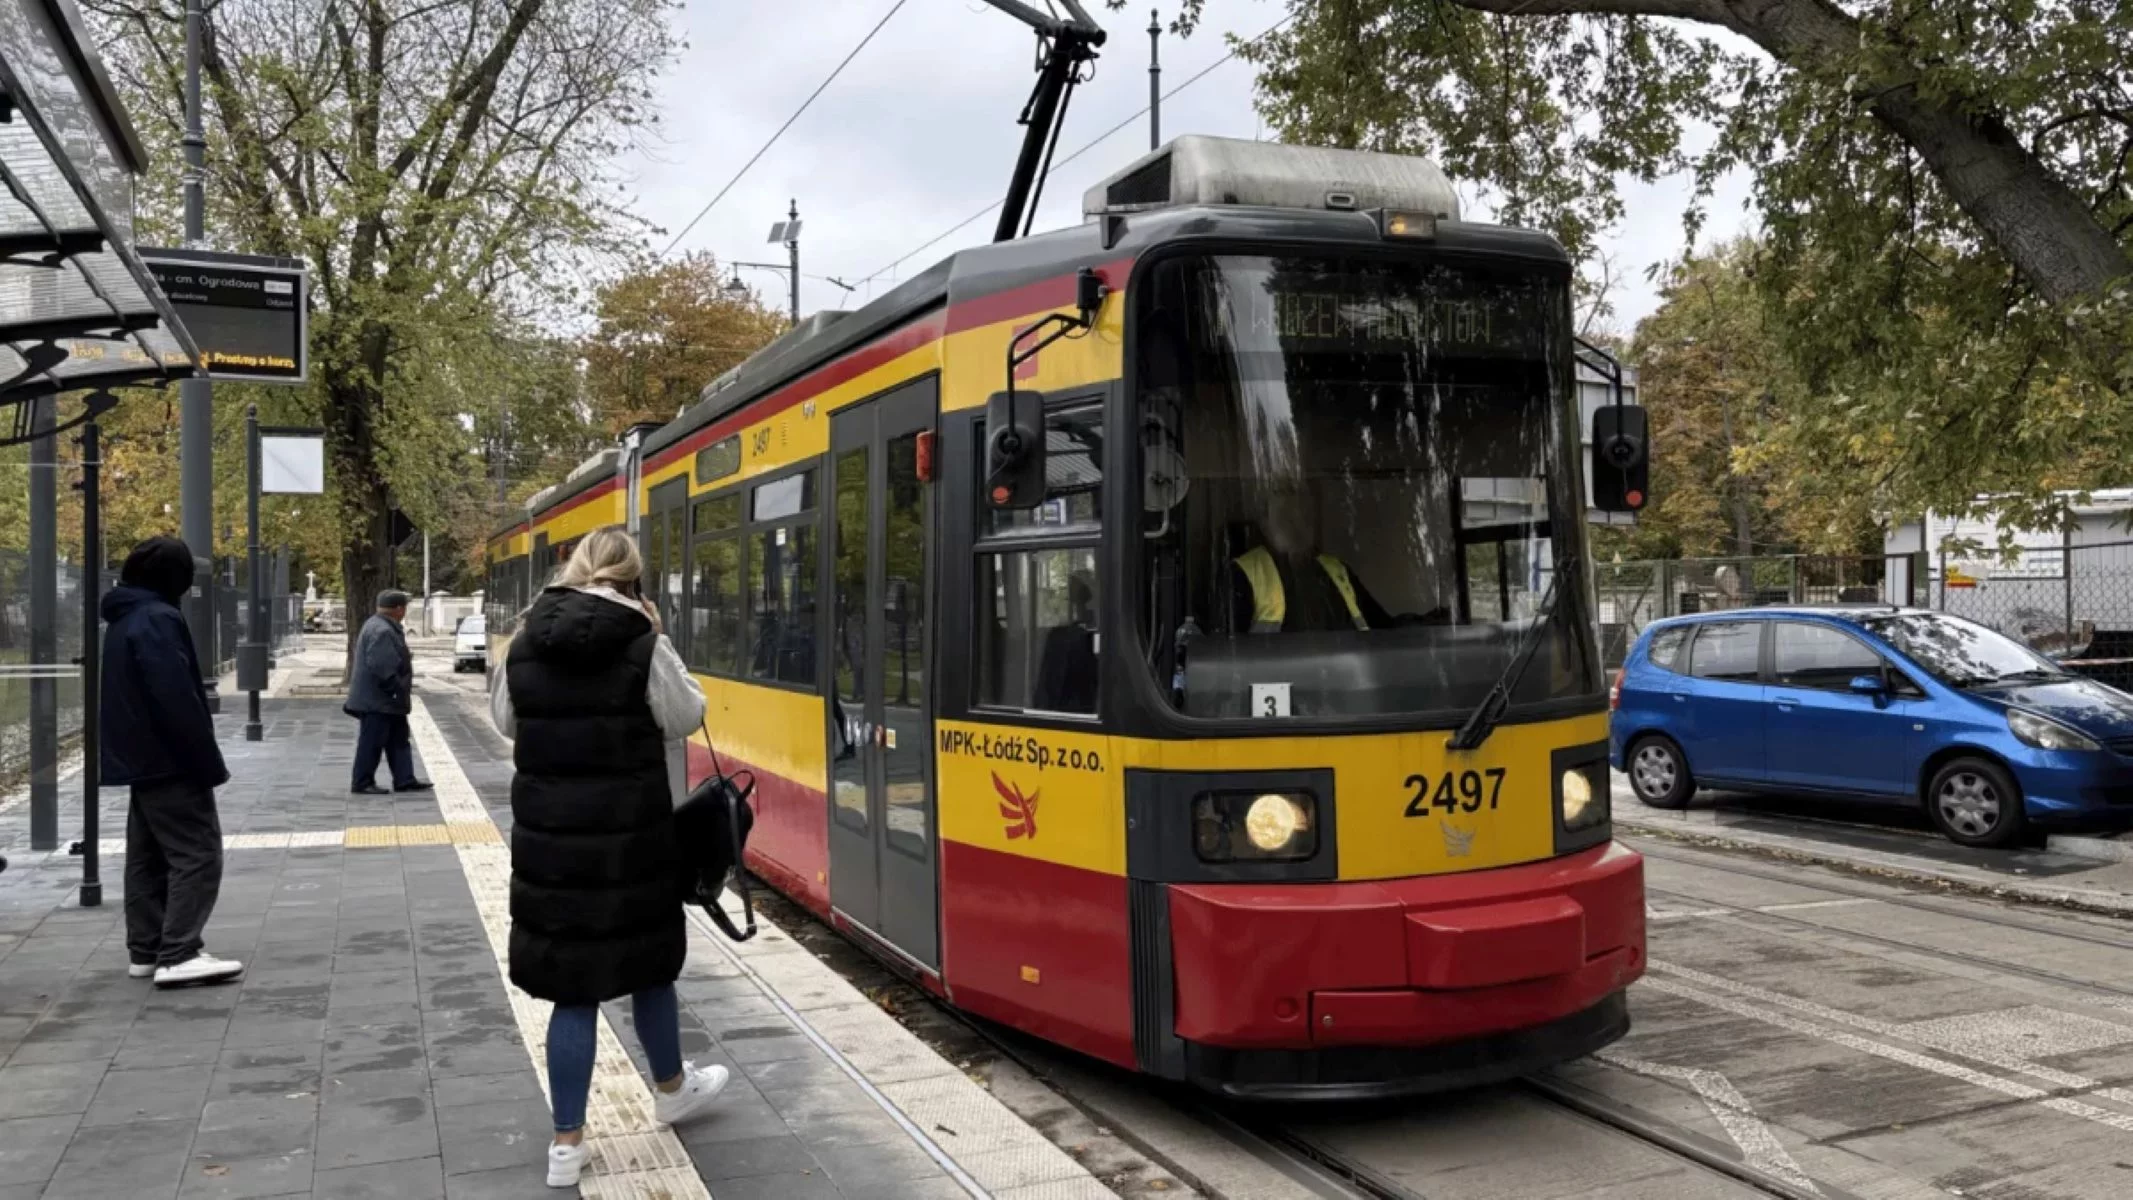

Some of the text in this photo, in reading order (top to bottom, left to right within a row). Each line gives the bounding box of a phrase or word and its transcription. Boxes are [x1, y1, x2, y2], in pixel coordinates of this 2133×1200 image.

[198, 274, 260, 290] Ogrodowa
[752, 426, 771, 457] 2497
[1264, 695, 1277, 718] 3
[939, 729, 1104, 772] MPK-Łódź Sp. z o.o.
[1403, 767, 1506, 818] 2497
